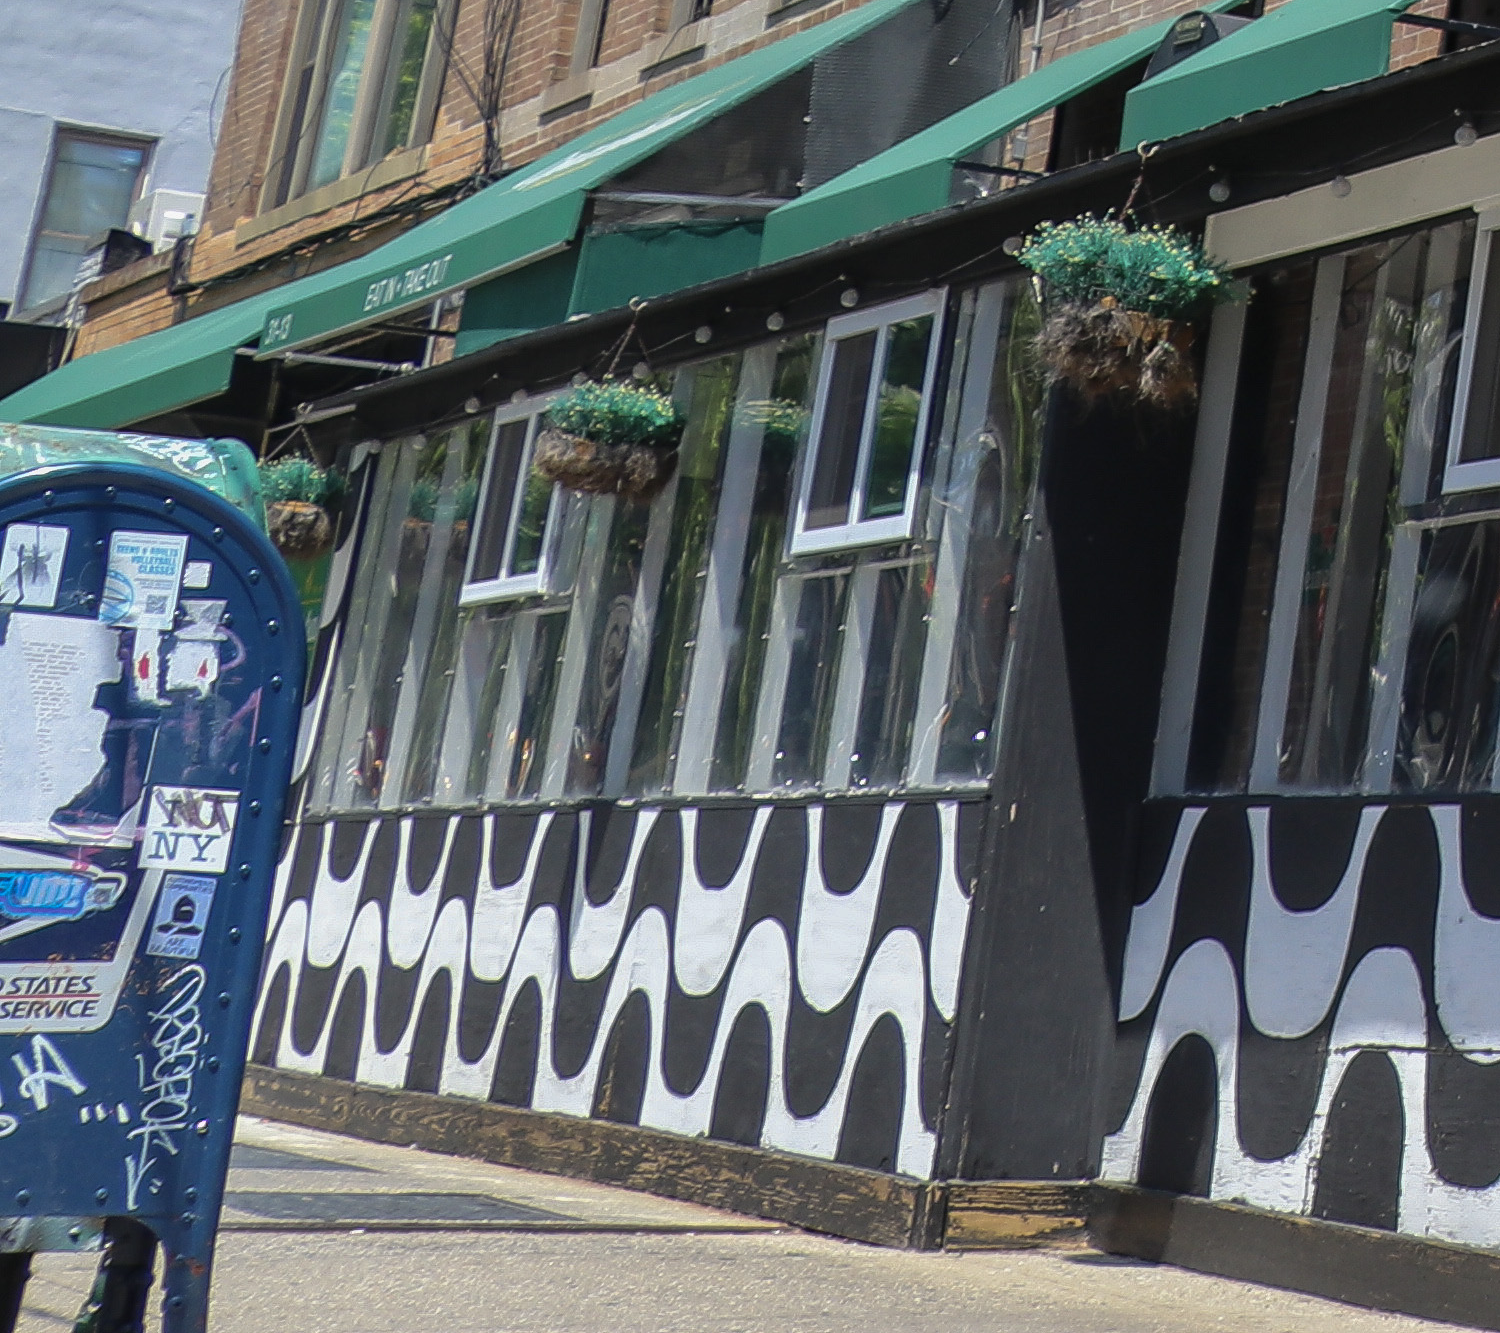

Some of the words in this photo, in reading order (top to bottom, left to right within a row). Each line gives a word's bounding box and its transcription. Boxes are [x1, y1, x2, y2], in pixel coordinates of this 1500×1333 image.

[363, 279, 388, 311] EAT
[6, 976, 97, 995] STATES
[0, 1000, 99, 1020] SERVICE
